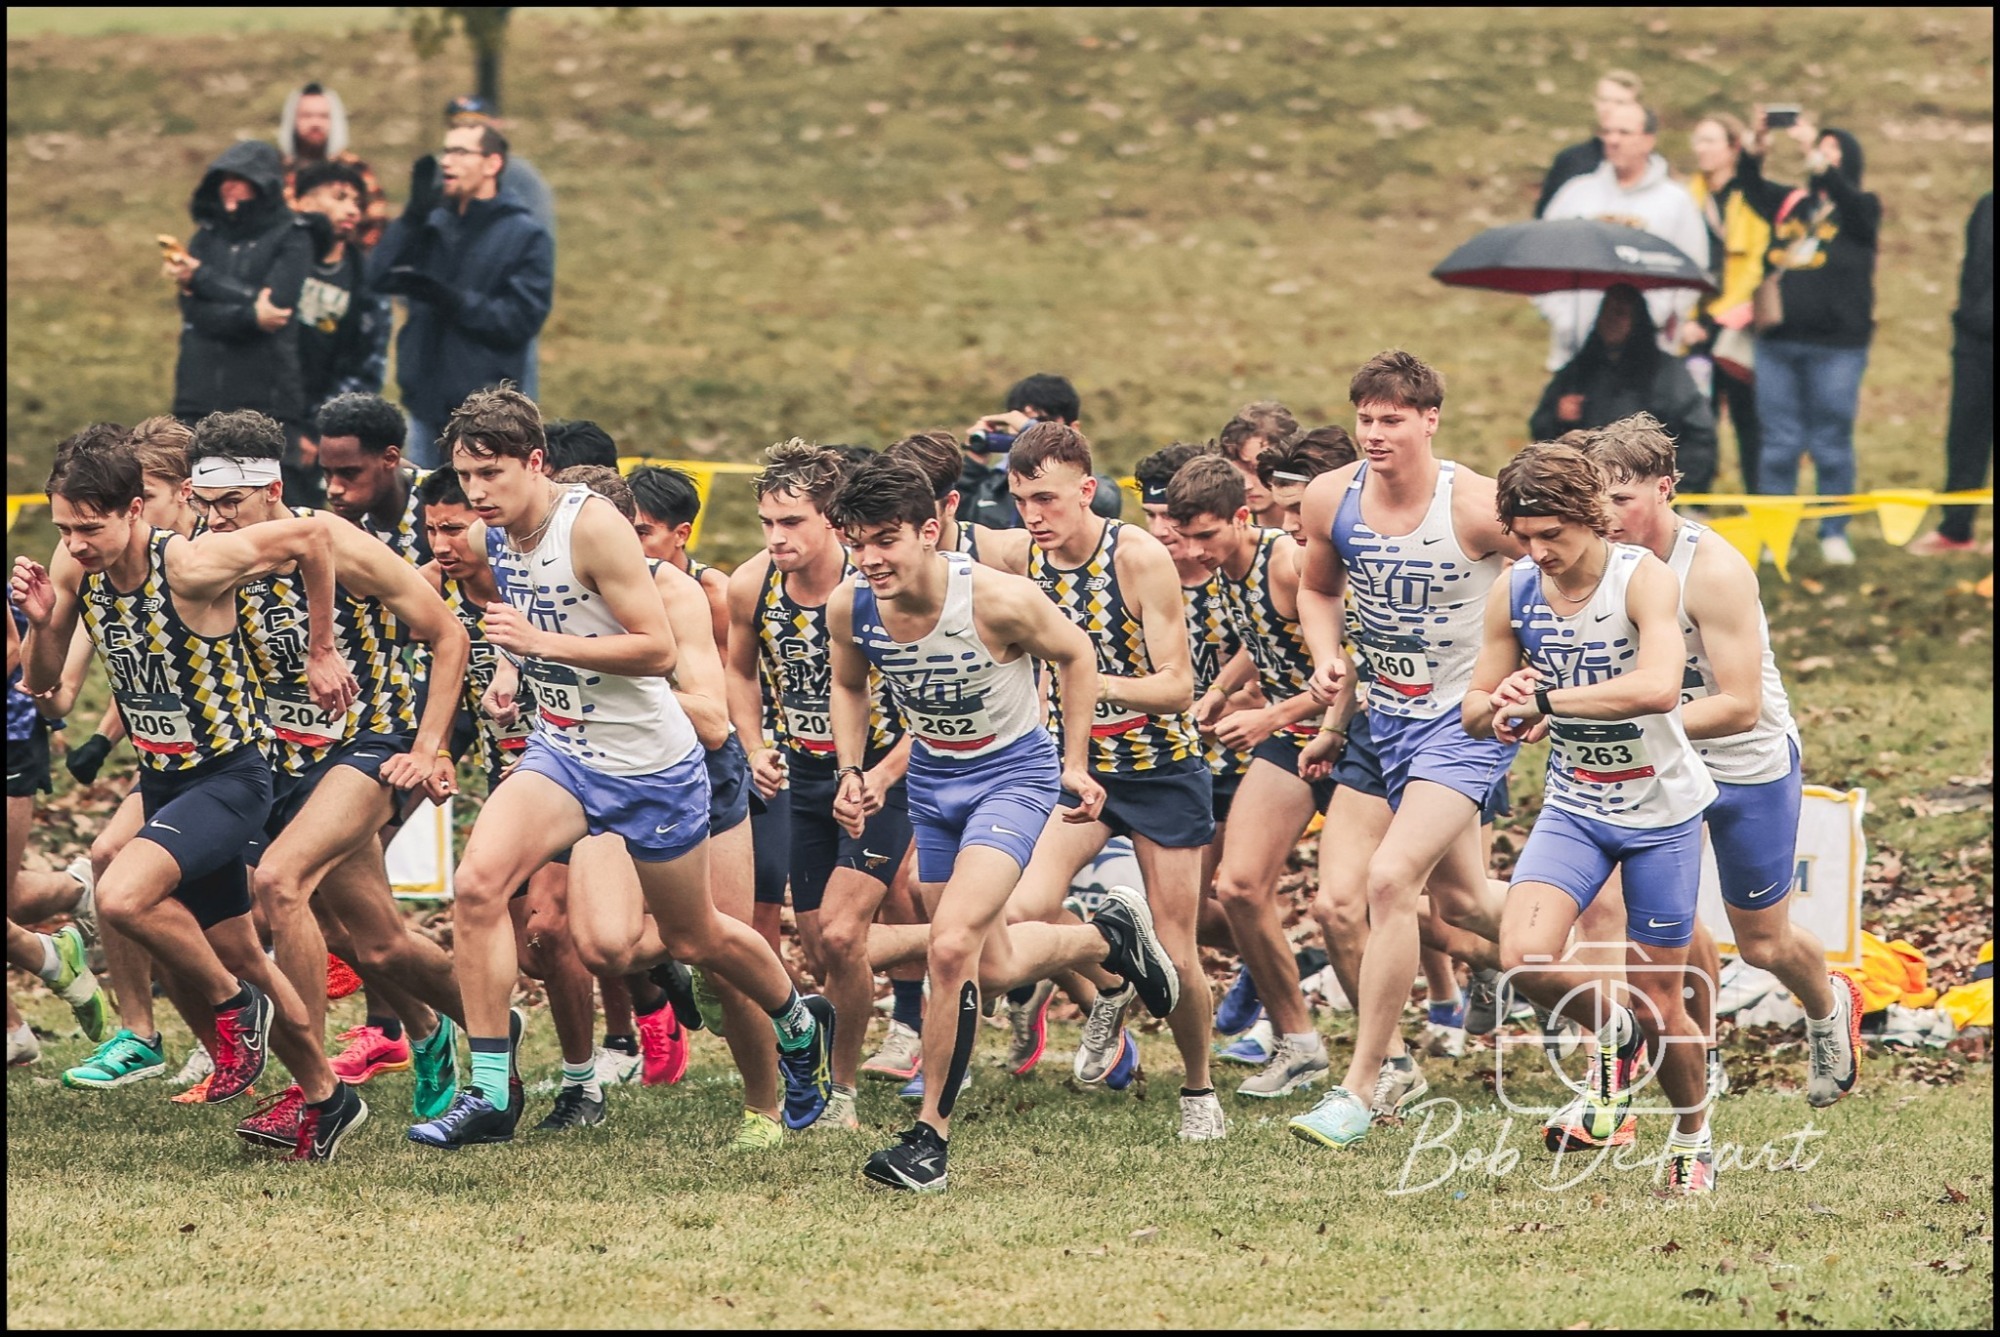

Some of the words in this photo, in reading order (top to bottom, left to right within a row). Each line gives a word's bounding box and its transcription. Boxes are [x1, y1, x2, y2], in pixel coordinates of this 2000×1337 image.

[1035, 579, 1054, 589] CAC
[1356, 555, 1431, 614] YU
[1373, 652, 1416, 678] 260
[535, 682, 571, 711] 258
[130, 712, 176, 736] 206
[279, 704, 334, 729] 204
[794, 713, 832, 734] 20
[918, 716, 977, 737] 262
[1576, 744, 1633, 766] 263
